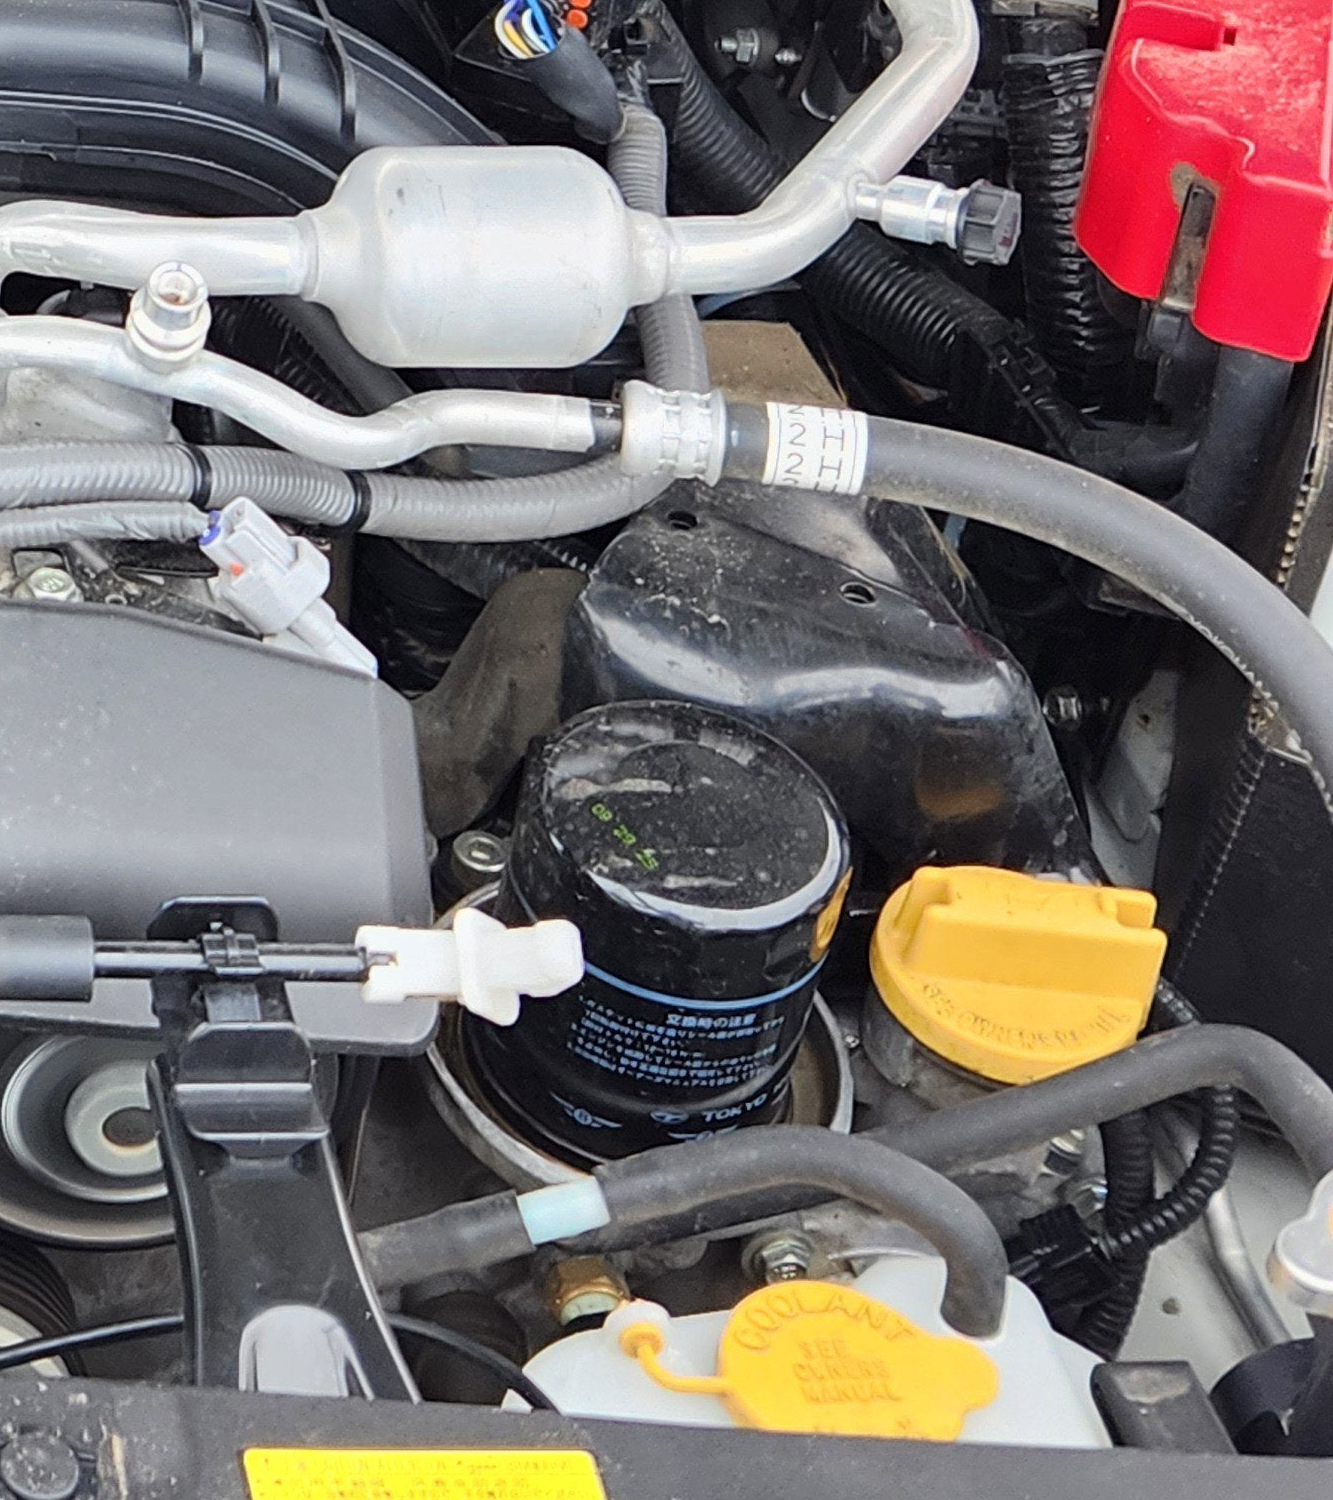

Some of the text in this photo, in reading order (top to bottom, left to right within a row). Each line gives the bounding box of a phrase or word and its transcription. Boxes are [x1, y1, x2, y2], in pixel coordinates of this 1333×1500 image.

[702, 1093, 769, 1122] TOKYO
[734, 1288, 916, 1351] COOLANT
[798, 1339, 848, 1360] SEE
[801, 1381, 903, 1403] MANUAL
